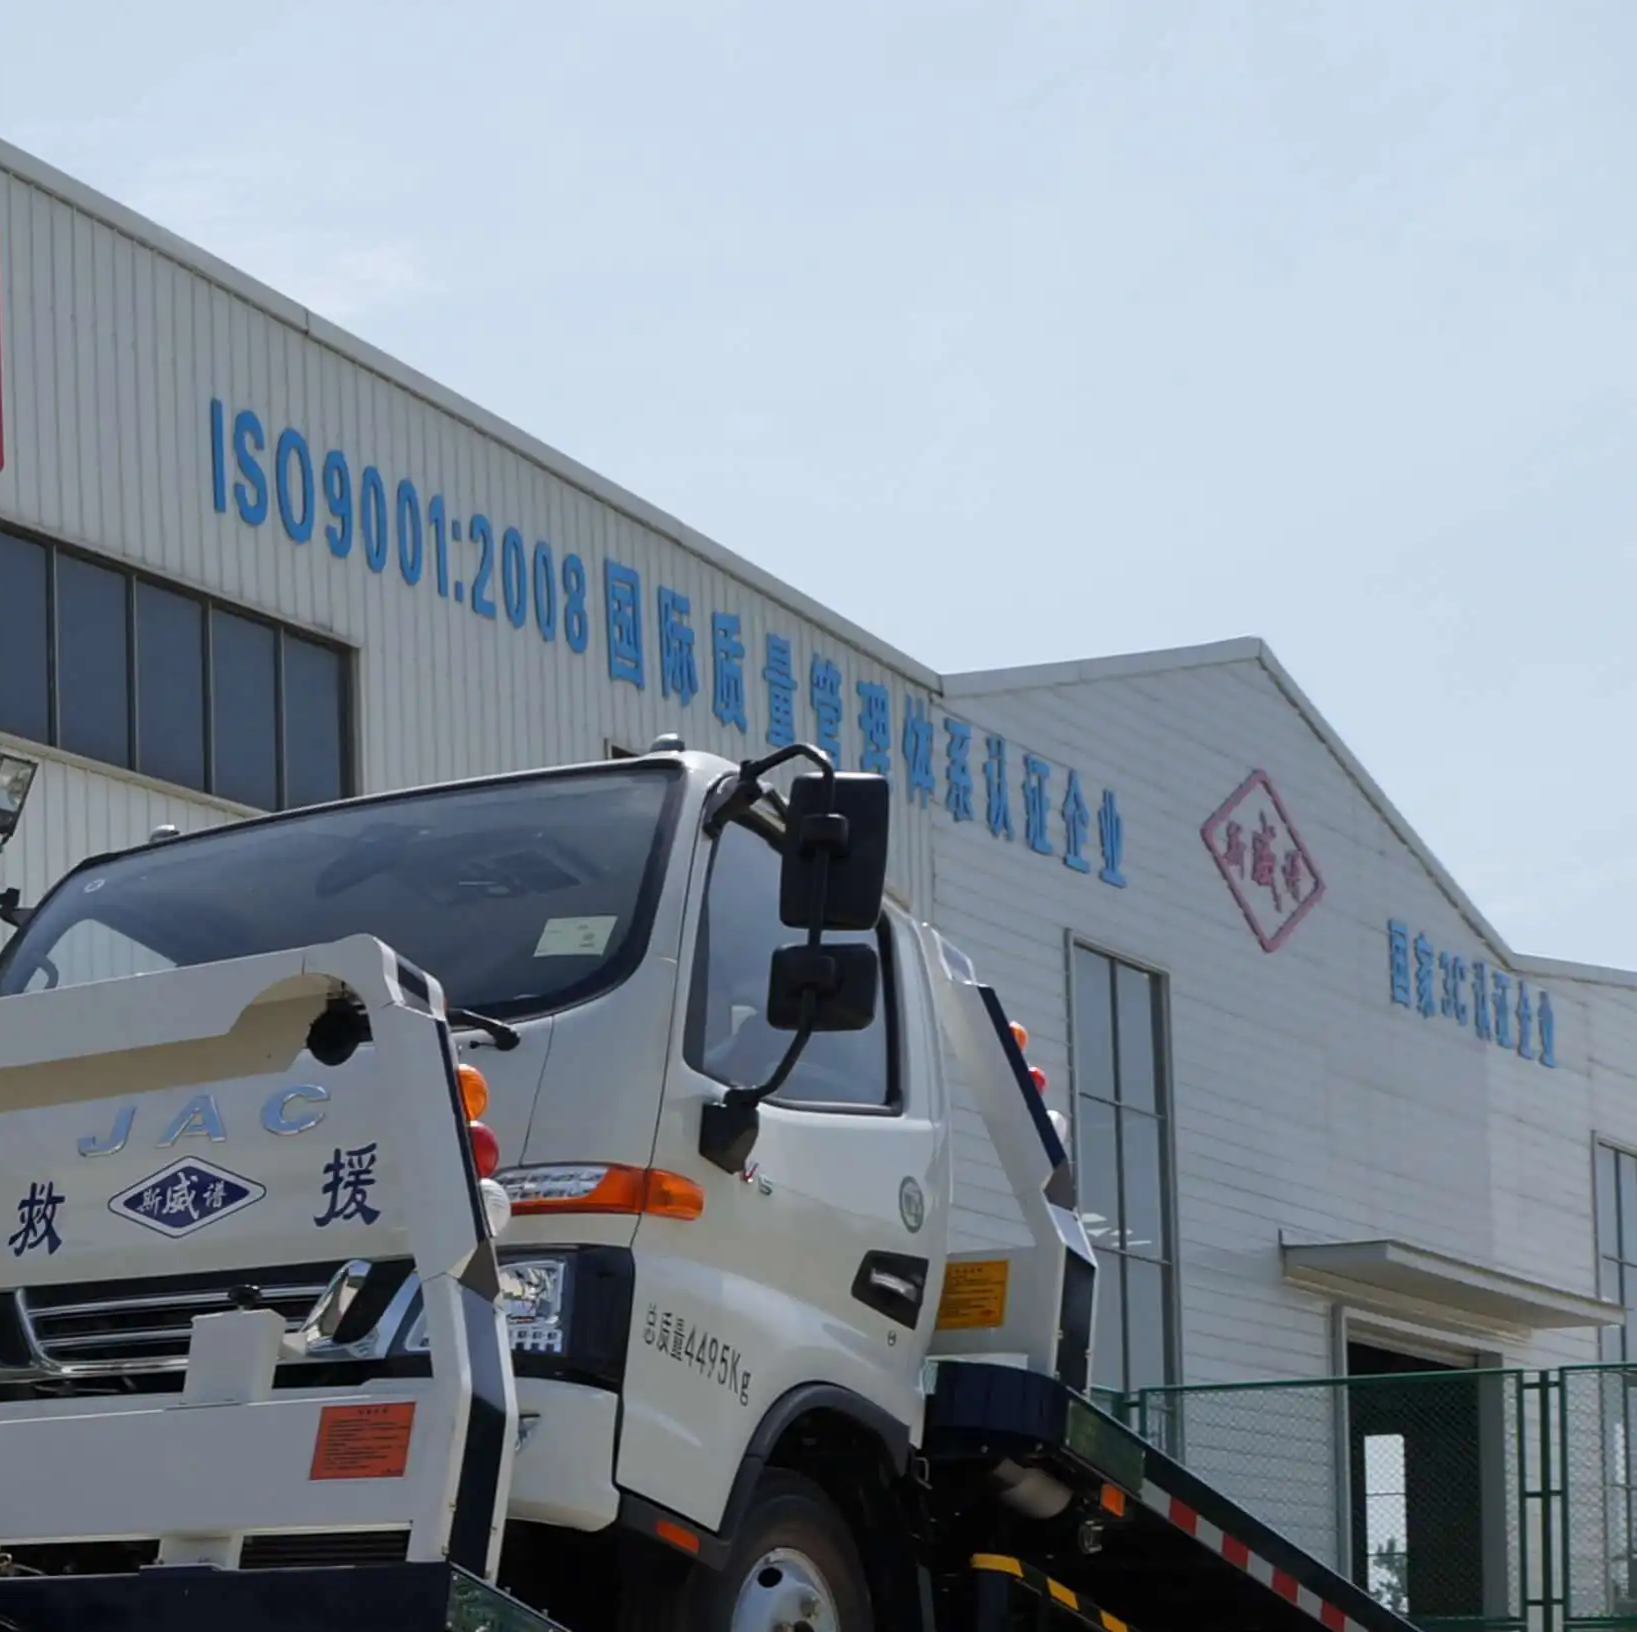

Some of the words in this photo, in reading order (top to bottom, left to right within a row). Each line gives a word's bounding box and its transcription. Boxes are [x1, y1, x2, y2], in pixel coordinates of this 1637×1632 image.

[76, 1083, 331, 1158] JAC
[7, 1180, 67, 1258] 救
[312, 1141, 383, 1228] 援
